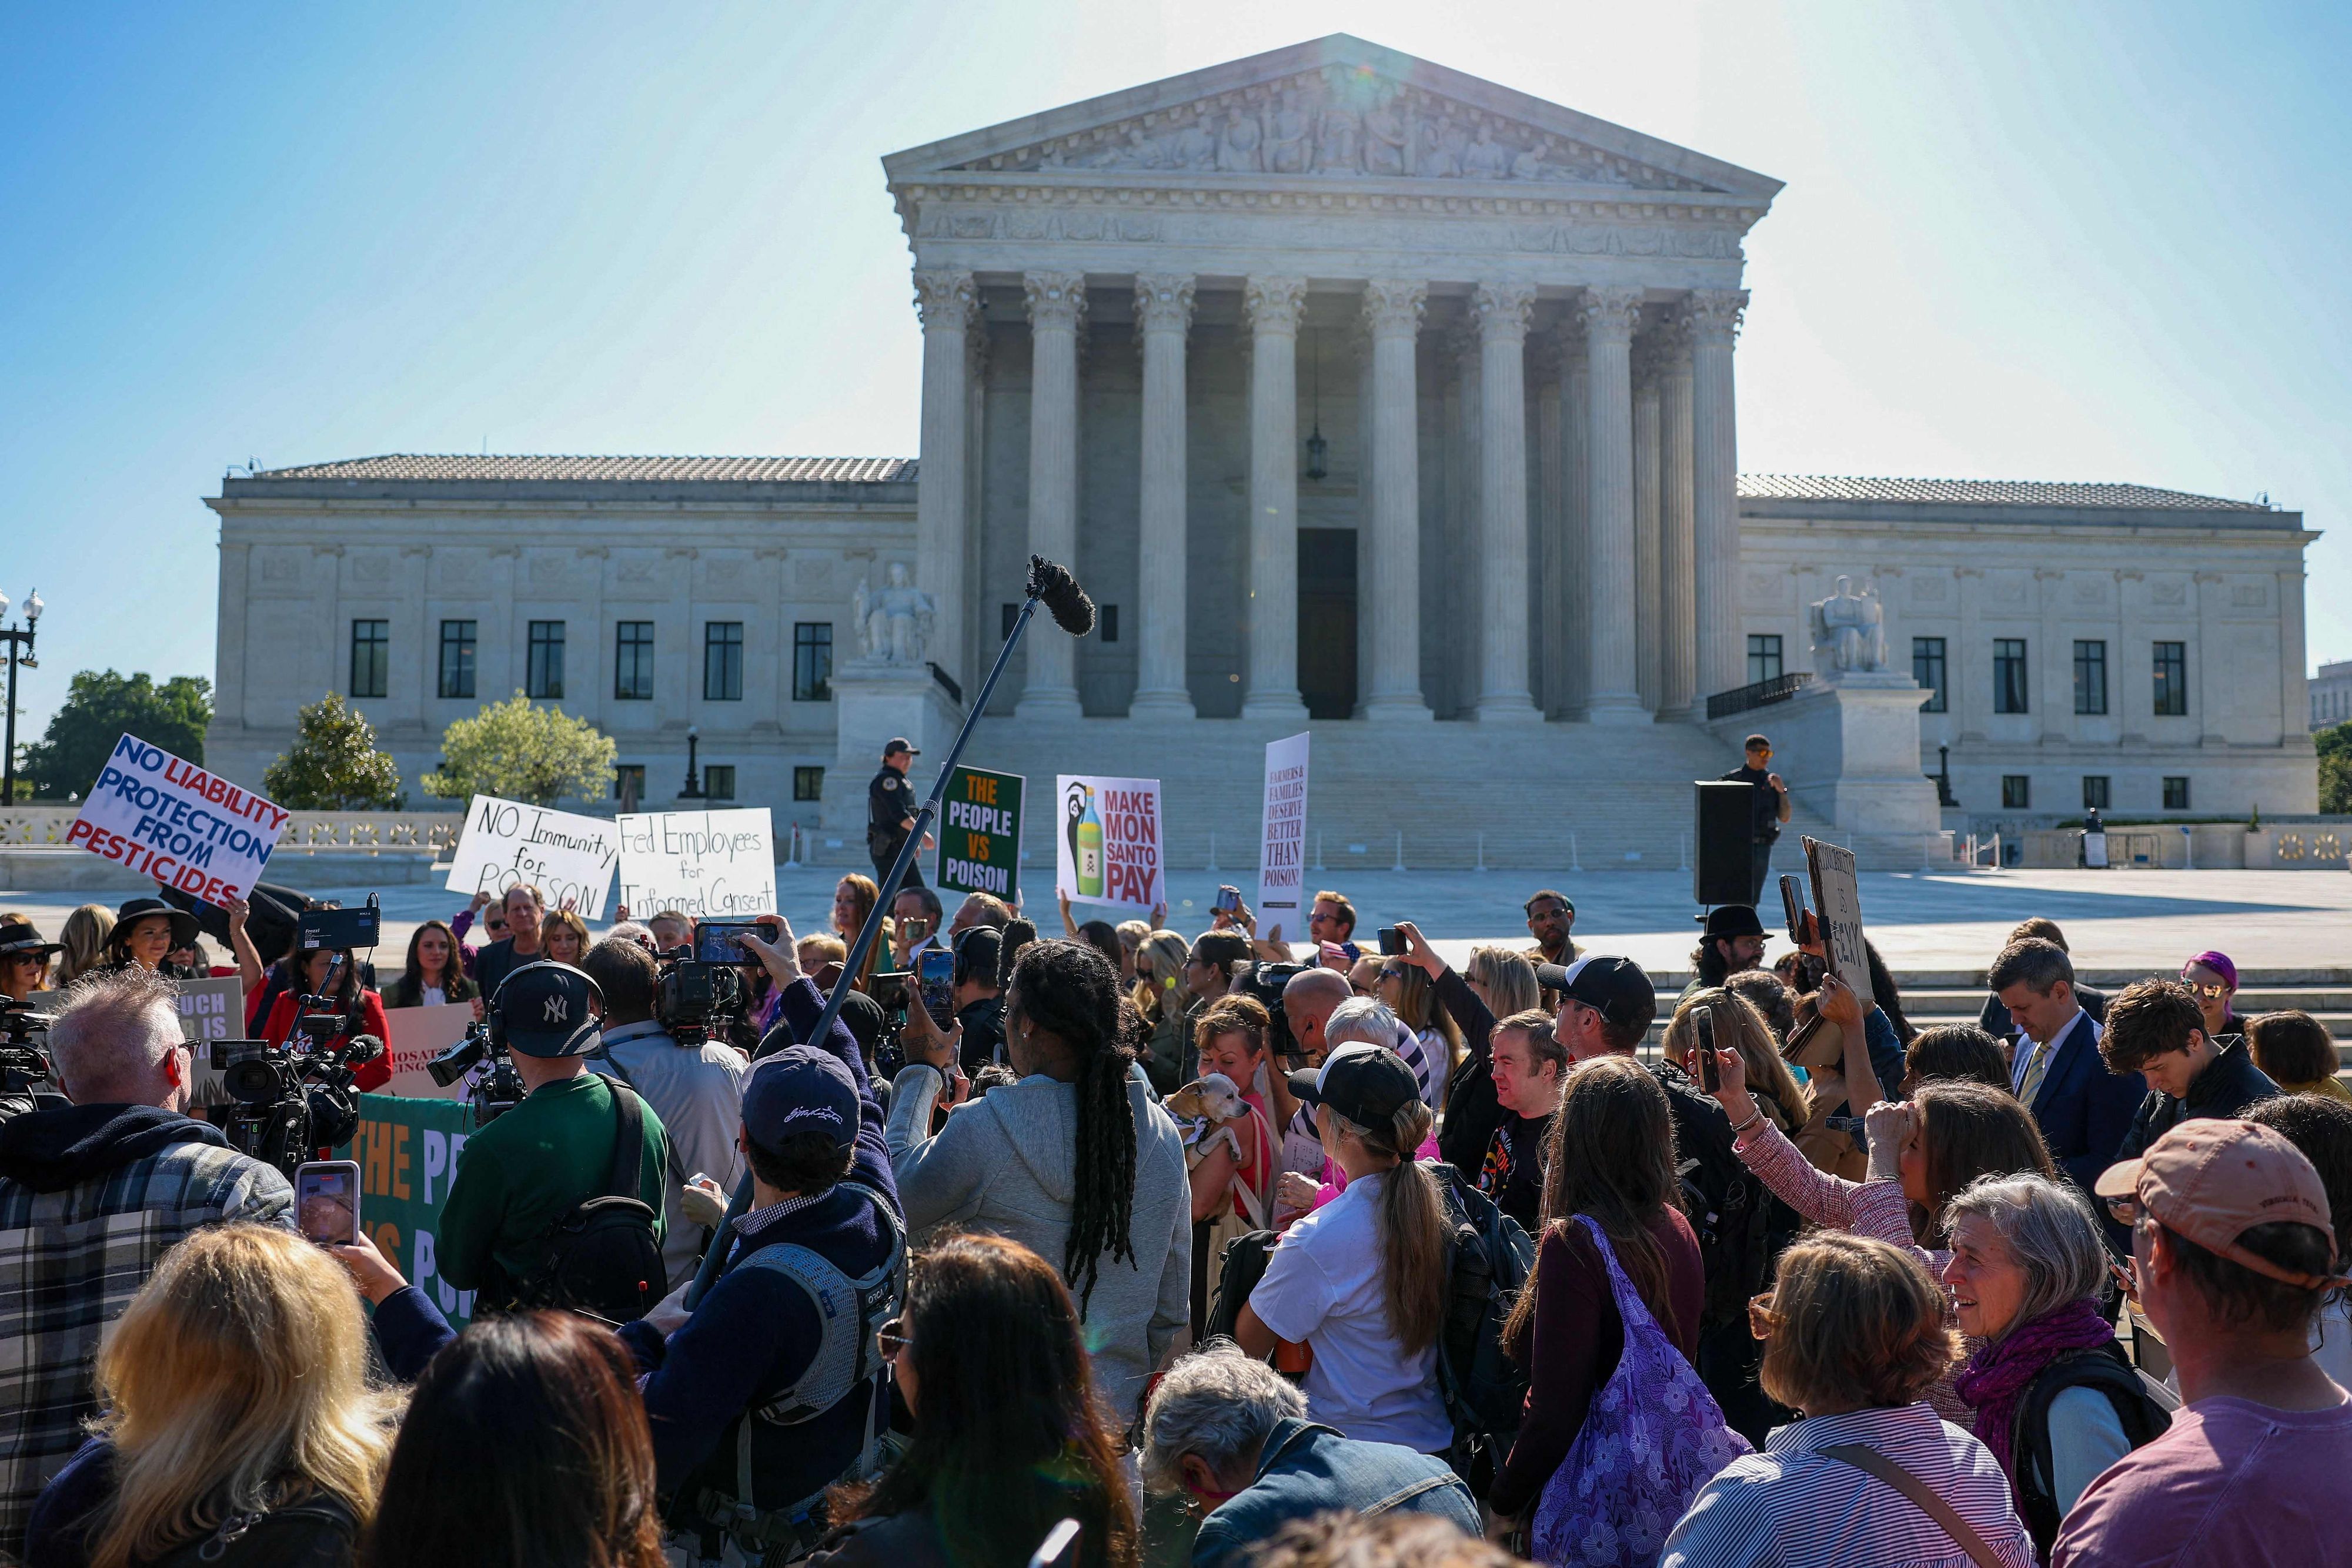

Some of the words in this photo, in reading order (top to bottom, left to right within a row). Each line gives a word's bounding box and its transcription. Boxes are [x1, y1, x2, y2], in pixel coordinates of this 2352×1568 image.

[115, 735, 164, 771] NO
[164, 758, 289, 831] LIABILITY
[1269, 766, 1299, 784] FARMERS
[1299, 765, 1304, 778] &
[966, 774, 998, 805] THE
[1105, 790, 1154, 815] MAKE
[1269, 780, 1304, 802] FAMILIES
[96, 767, 273, 865] PROTECTION
[948, 800, 1012, 837] PEOPLE
[1268, 799, 1302, 820] DESERVE
[132, 815, 214, 868] FROM
[477, 801, 520, 838] NO
[521, 808, 616, 870] Immunity
[620, 815, 655, 854] Fed
[663, 812, 762, 863] Employees
[1105, 813, 1156, 845] MON
[1267, 819, 1301, 841] BETTER
[513, 847, 546, 873] for
[967, 833, 990, 861] VS
[1107, 842, 1157, 866] SANTO
[1267, 840, 1301, 867] THAN
[66, 819, 239, 908] PESTICIDES
[679, 859, 705, 880] for
[946, 857, 1008, 895] POISON
[1264, 868, 1299, 887] POISON!
[620, 884, 709, 918] Informed
[710, 877, 773, 912] Consent
[1107, 862, 1157, 905] PAY
[542, 994, 568, 1023] NY
[868, 1288, 884, 1304] ORCA
